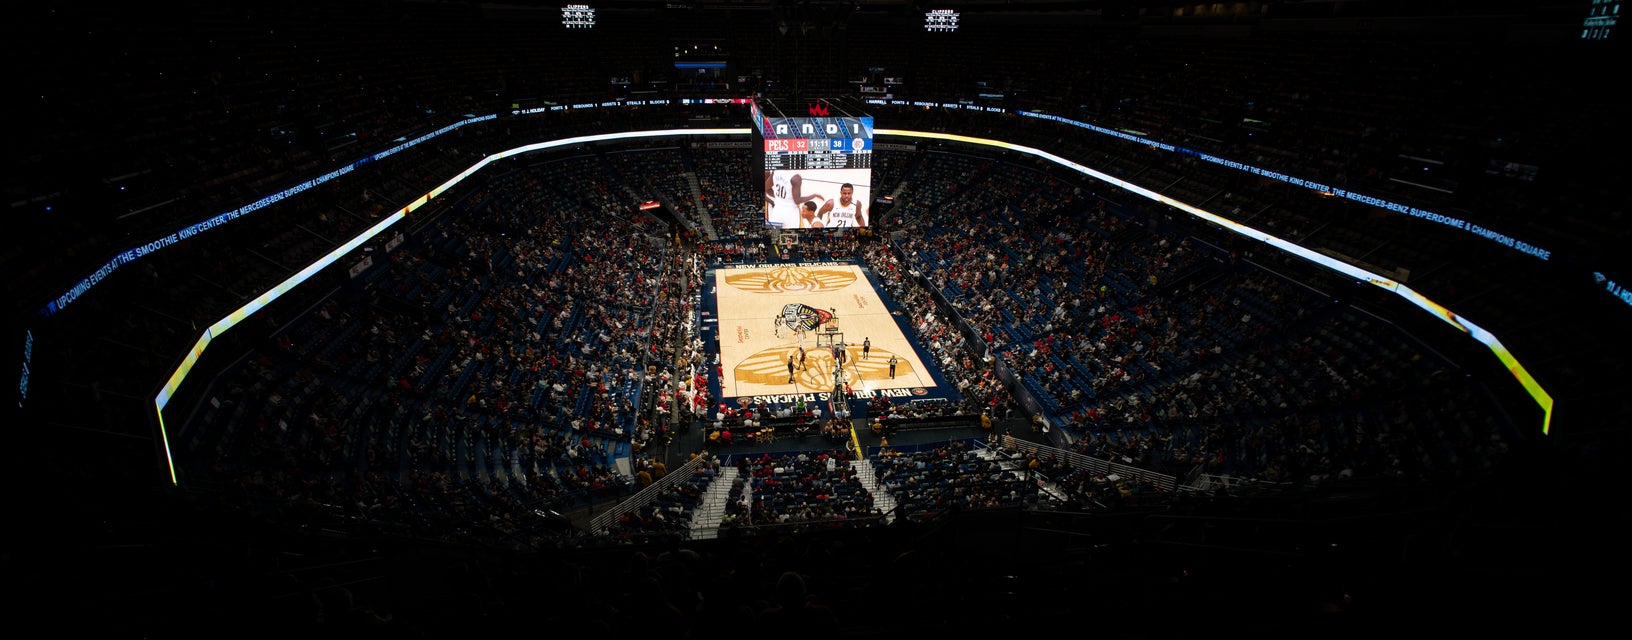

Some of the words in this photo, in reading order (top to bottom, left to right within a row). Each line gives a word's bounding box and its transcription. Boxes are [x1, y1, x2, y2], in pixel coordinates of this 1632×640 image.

[768, 140, 789, 150] PELS
[776, 184, 786, 199] 30
[1201, 154, 1224, 165] UPCOMING
[1224, 160, 1242, 170] EVENTS
[1250, 166, 1260, 175] THE
[1261, 169, 1288, 182] SMOOTHIE
[1289, 176, 1304, 186] KING
[1332, 187, 1345, 198] THE
[1346, 191, 1410, 214] MERCEDES-BENZ
[1409, 208, 1465, 229] SUPERDOME
[1471, 224, 1515, 248] CHAMPIONS
[1514, 240, 1551, 261] SQUARE
[56, 278, 91, 310] UPCOMING
[90, 263, 112, 286] EVENTS
[117, 250, 135, 265] THE
[135, 233, 179, 258] SMOOTHIE
[178, 226, 198, 240] KING
[198, 215, 227, 232] CENTER,
[227, 210, 240, 221] THE
[240, 191, 285, 216] MERCEDES-BENZ
[284, 180, 313, 198] SUPERDOME
[881, 388, 912, 398] NEW
